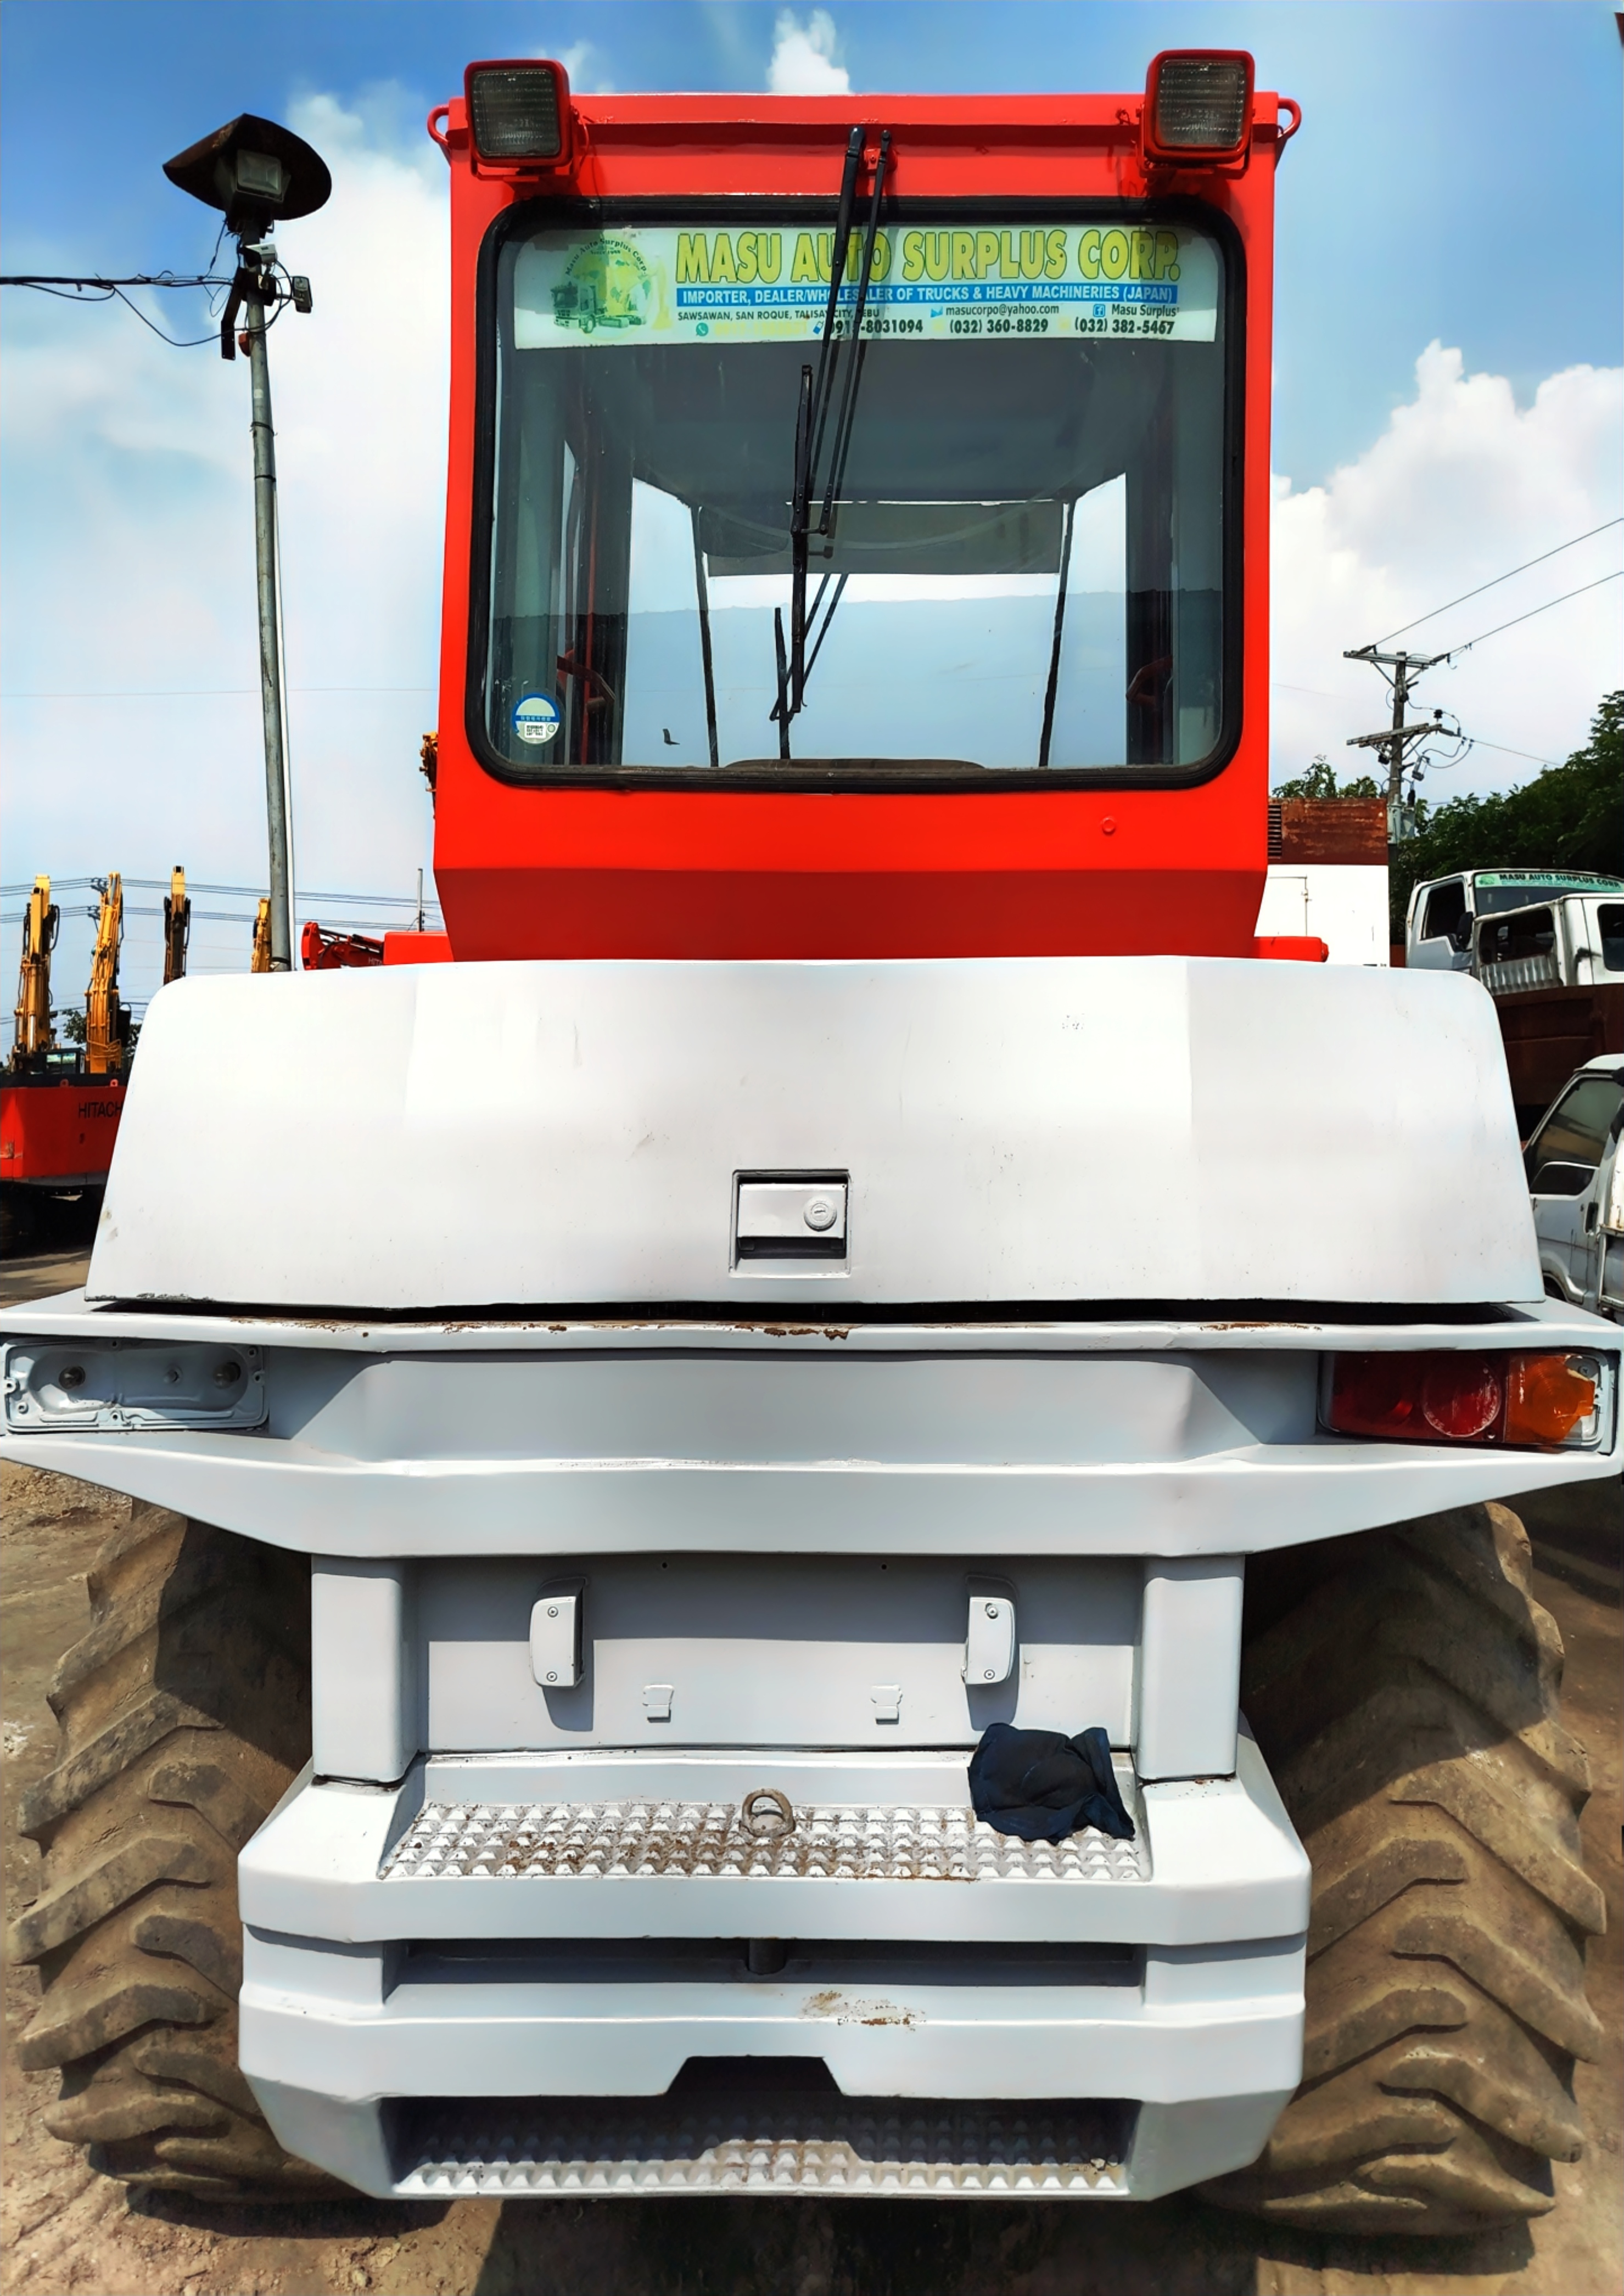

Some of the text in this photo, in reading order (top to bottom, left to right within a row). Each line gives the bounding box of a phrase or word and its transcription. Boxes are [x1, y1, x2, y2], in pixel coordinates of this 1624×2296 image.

[580, 240, 598, 254] Auto
[600, 238, 631, 252] Surplus
[676, 229, 1181, 283] MASU AUTO SURPLUS CORP.
[683, 290, 751, 306] IMPORTER,
[897, 288, 914, 301] OF
[917, 287, 969, 300] TRUCKS
[973, 287, 982, 299] &
[987, 286, 1028, 299] HEAVY
[1032, 285, 1119, 299] MACHINERIES
[1123, 286, 1172, 302] (JAPAN)
[678, 311, 732, 321] SAWSAWAN,
[736, 311, 754, 320] SAN
[758, 311, 792, 320] ROQUE,
[862, 309, 880, 318] EBU
[946, 304, 1060, 317] masucorpo@yahoo.com
[1112, 304, 1137, 316] Masu
[950, 318, 1049, 334] (032) 360-8829
[1075, 317, 1108, 333] (032)
[1555, 874, 1594, 884] SURPLUS
